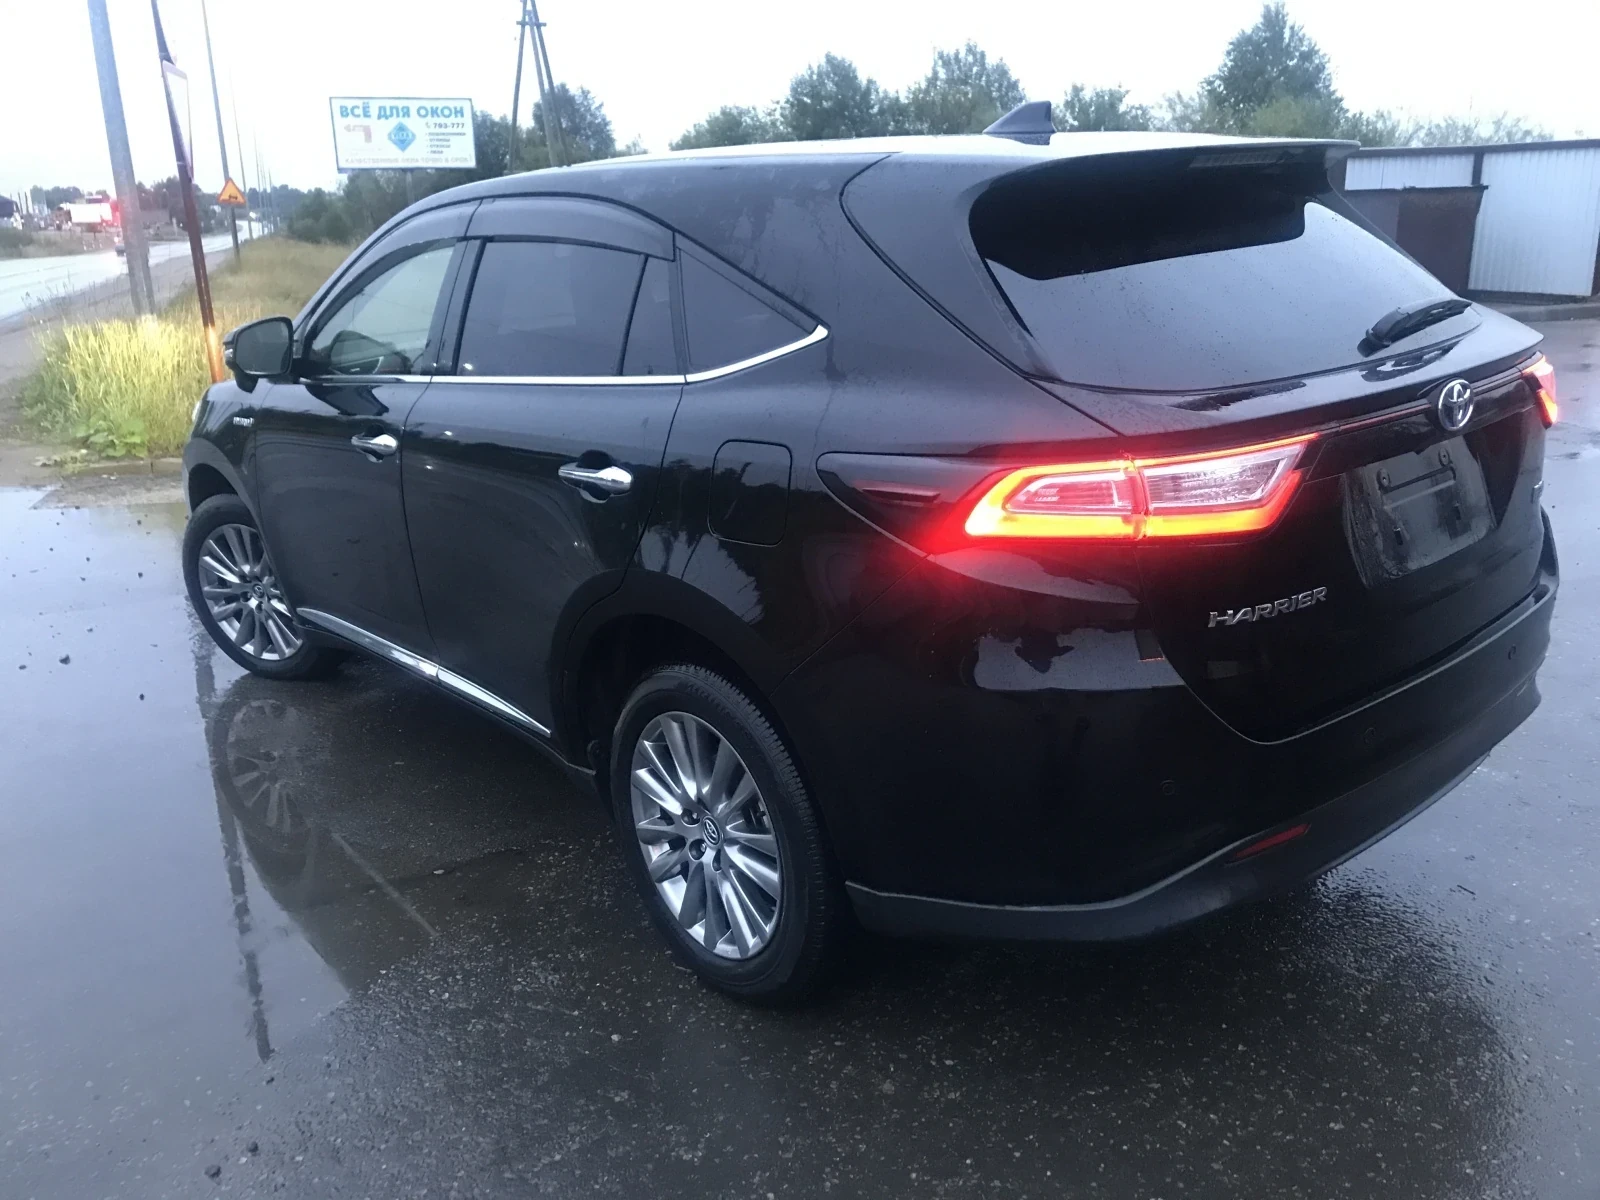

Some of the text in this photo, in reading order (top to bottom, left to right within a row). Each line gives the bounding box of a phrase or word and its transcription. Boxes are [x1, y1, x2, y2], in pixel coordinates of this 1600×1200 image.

[340, 101, 465, 120] ВСЁ ДЛЯ ОКОН
[1208, 586, 1328, 628] HARRIER
